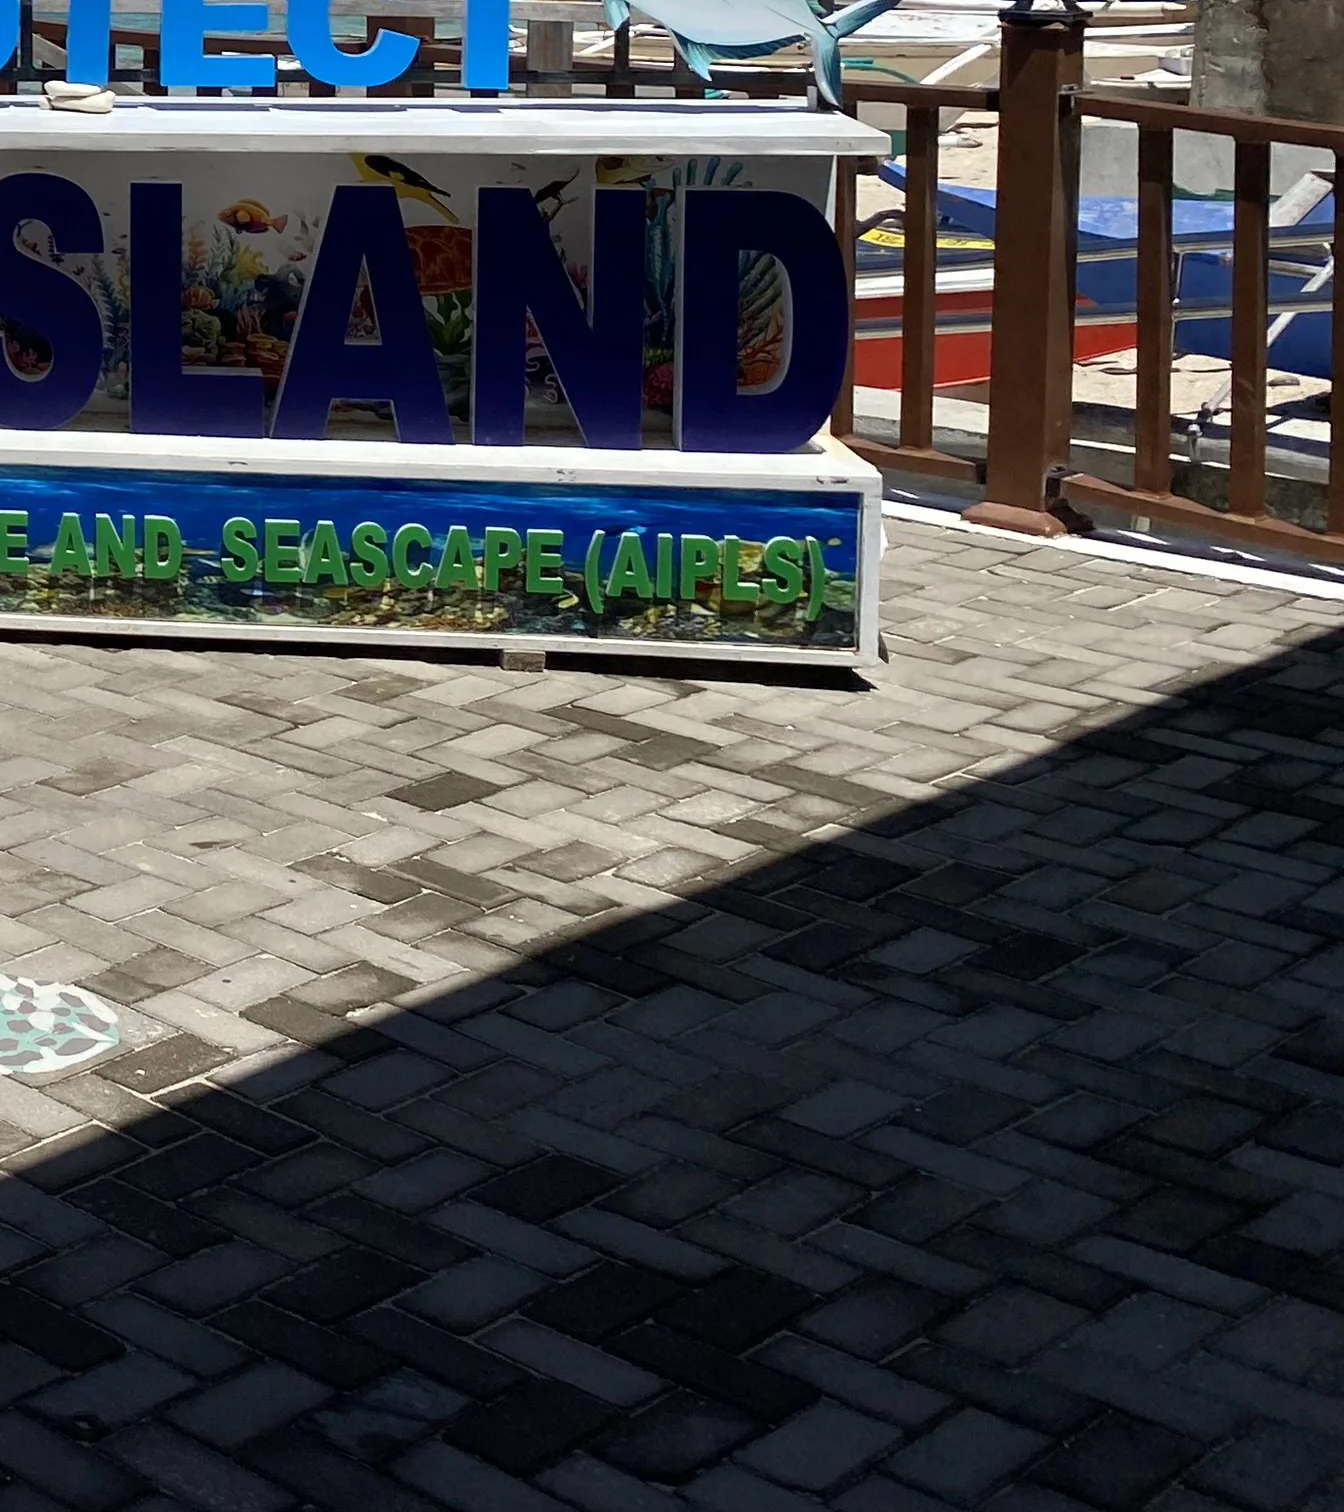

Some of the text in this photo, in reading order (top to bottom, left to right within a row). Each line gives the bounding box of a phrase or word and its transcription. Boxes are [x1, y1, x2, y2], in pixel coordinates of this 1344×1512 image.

[50, 512, 183, 580] AND
[220, 517, 564, 594] SEASCAPE
[585, 530, 825, 621] (AIPLS)
